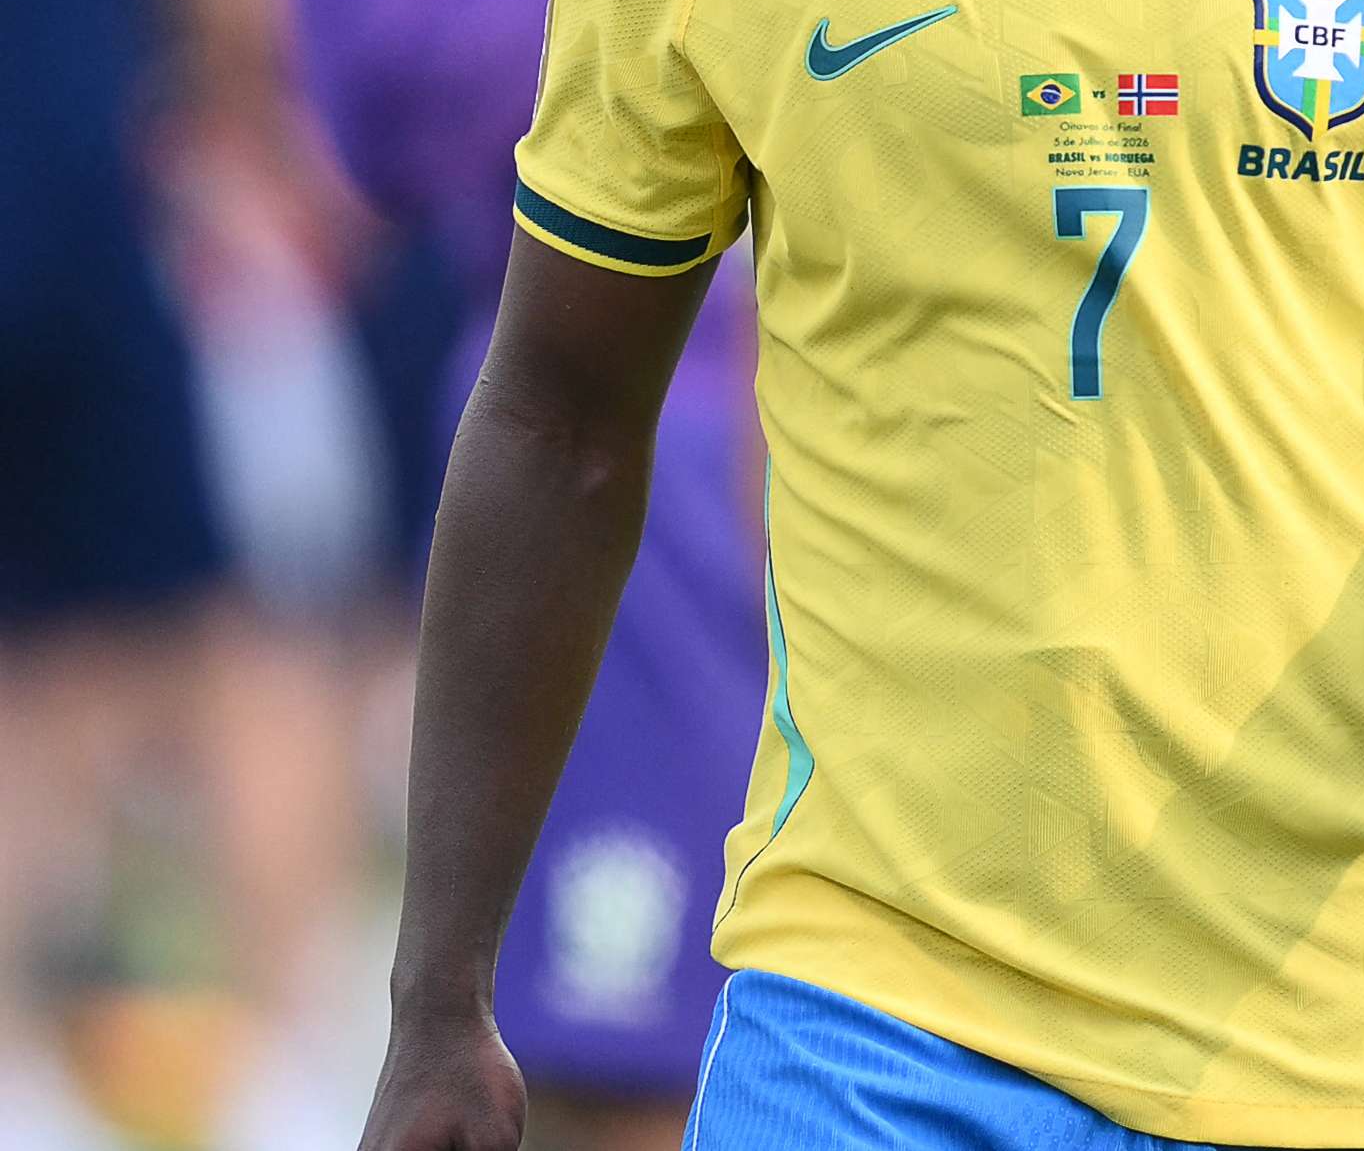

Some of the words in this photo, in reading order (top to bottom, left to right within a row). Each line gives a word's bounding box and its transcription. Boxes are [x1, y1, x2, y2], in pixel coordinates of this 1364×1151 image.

[1295, 24, 1346, 47] CBF
[1092, 90, 1106, 99] vs
[1117, 122, 1142, 132] Final
[1054, 137, 1060, 146] 5
[1063, 137, 1075, 146] de
[1122, 137, 1149, 147] 2026
[1048, 151, 1086, 163] BRASIL
[1090, 154, 1101, 162] vs
[1105, 152, 1155, 163] NORUEGA
[1056, 167, 1084, 176] Nova
[1127, 167, 1150, 177] EUA
[1052, 186, 1151, 401] 7
